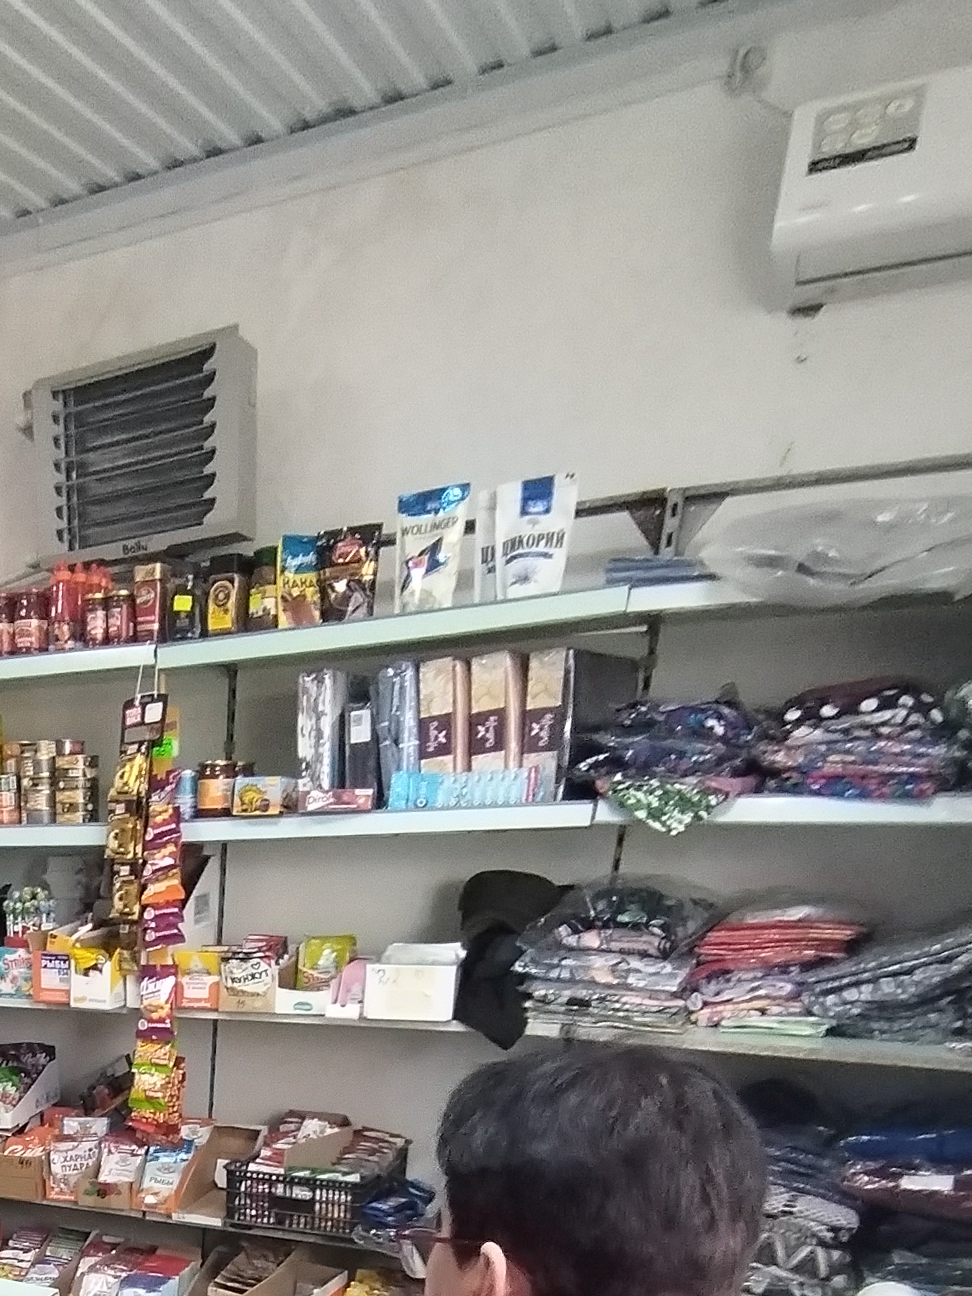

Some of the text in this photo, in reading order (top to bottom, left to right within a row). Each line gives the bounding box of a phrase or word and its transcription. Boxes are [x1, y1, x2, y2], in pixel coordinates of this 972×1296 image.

[501, 529, 566, 557] ЦИКОРИЙ
[40, 959, 69, 969] РЫБЫ
[230, 968, 269, 984] КУНЖУТ
[52, 1148, 96, 1165] СХАРНАЯ
[149, 1176, 175, 1187] РЫБЫ
